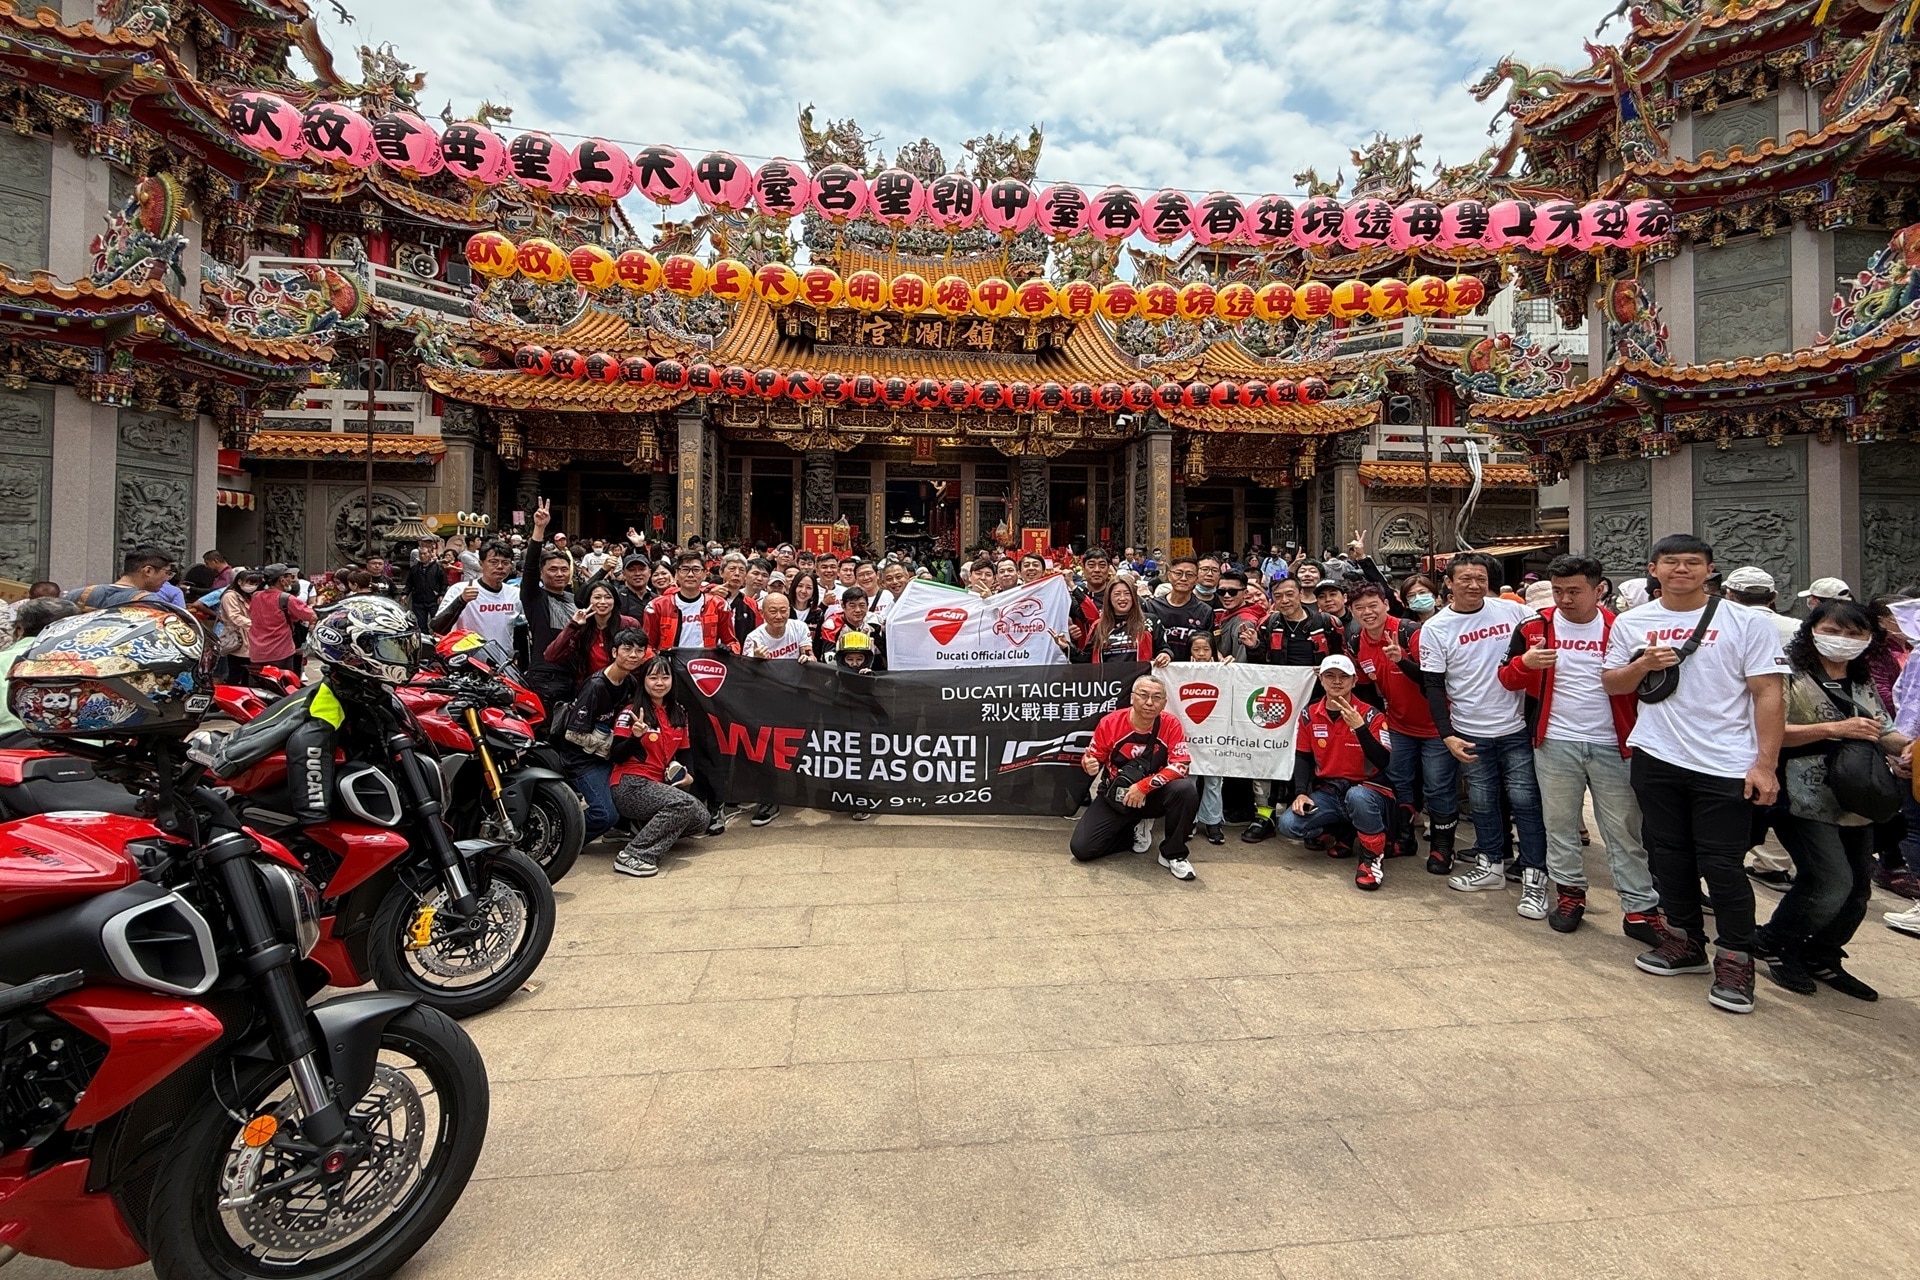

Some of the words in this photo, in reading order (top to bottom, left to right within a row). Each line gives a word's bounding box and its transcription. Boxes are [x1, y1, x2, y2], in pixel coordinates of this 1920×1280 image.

[480, 604, 514, 612] DUCATI
[318, 628, 341, 642] Arai
[1459, 624, 1511, 645] DUCATI
[1554, 640, 1605, 651] DUCAT
[936, 651, 969, 661] Ducati
[971, 650, 1005, 660] Official
[1007, 649, 1030, 660] Club
[691, 664, 723, 674] DUCATI
[941, 684, 1013, 701] DUCATI
[1017, 680, 1123, 699] TAICHUNG
[1182, 688, 1217, 696] DUCATI
[707, 712, 806, 771] WE
[806, 730, 860, 755] ARE
[870, 734, 977, 758] DUCATI
[1182, 736, 1213, 744] ucati
[1217, 736, 1260, 748] Official
[1264, 739, 1289, 749] Club
[1213, 749, 1252, 760] Taichung
[797, 755, 862, 781] RIDE
[868, 757, 908, 782] AS
[911, 757, 976, 783] ONE
[306, 746, 325, 808] DUCATI
[831, 790, 879, 809] May
[935, 786, 992, 805] 2026
[234, 1153, 252, 1191] brembo
